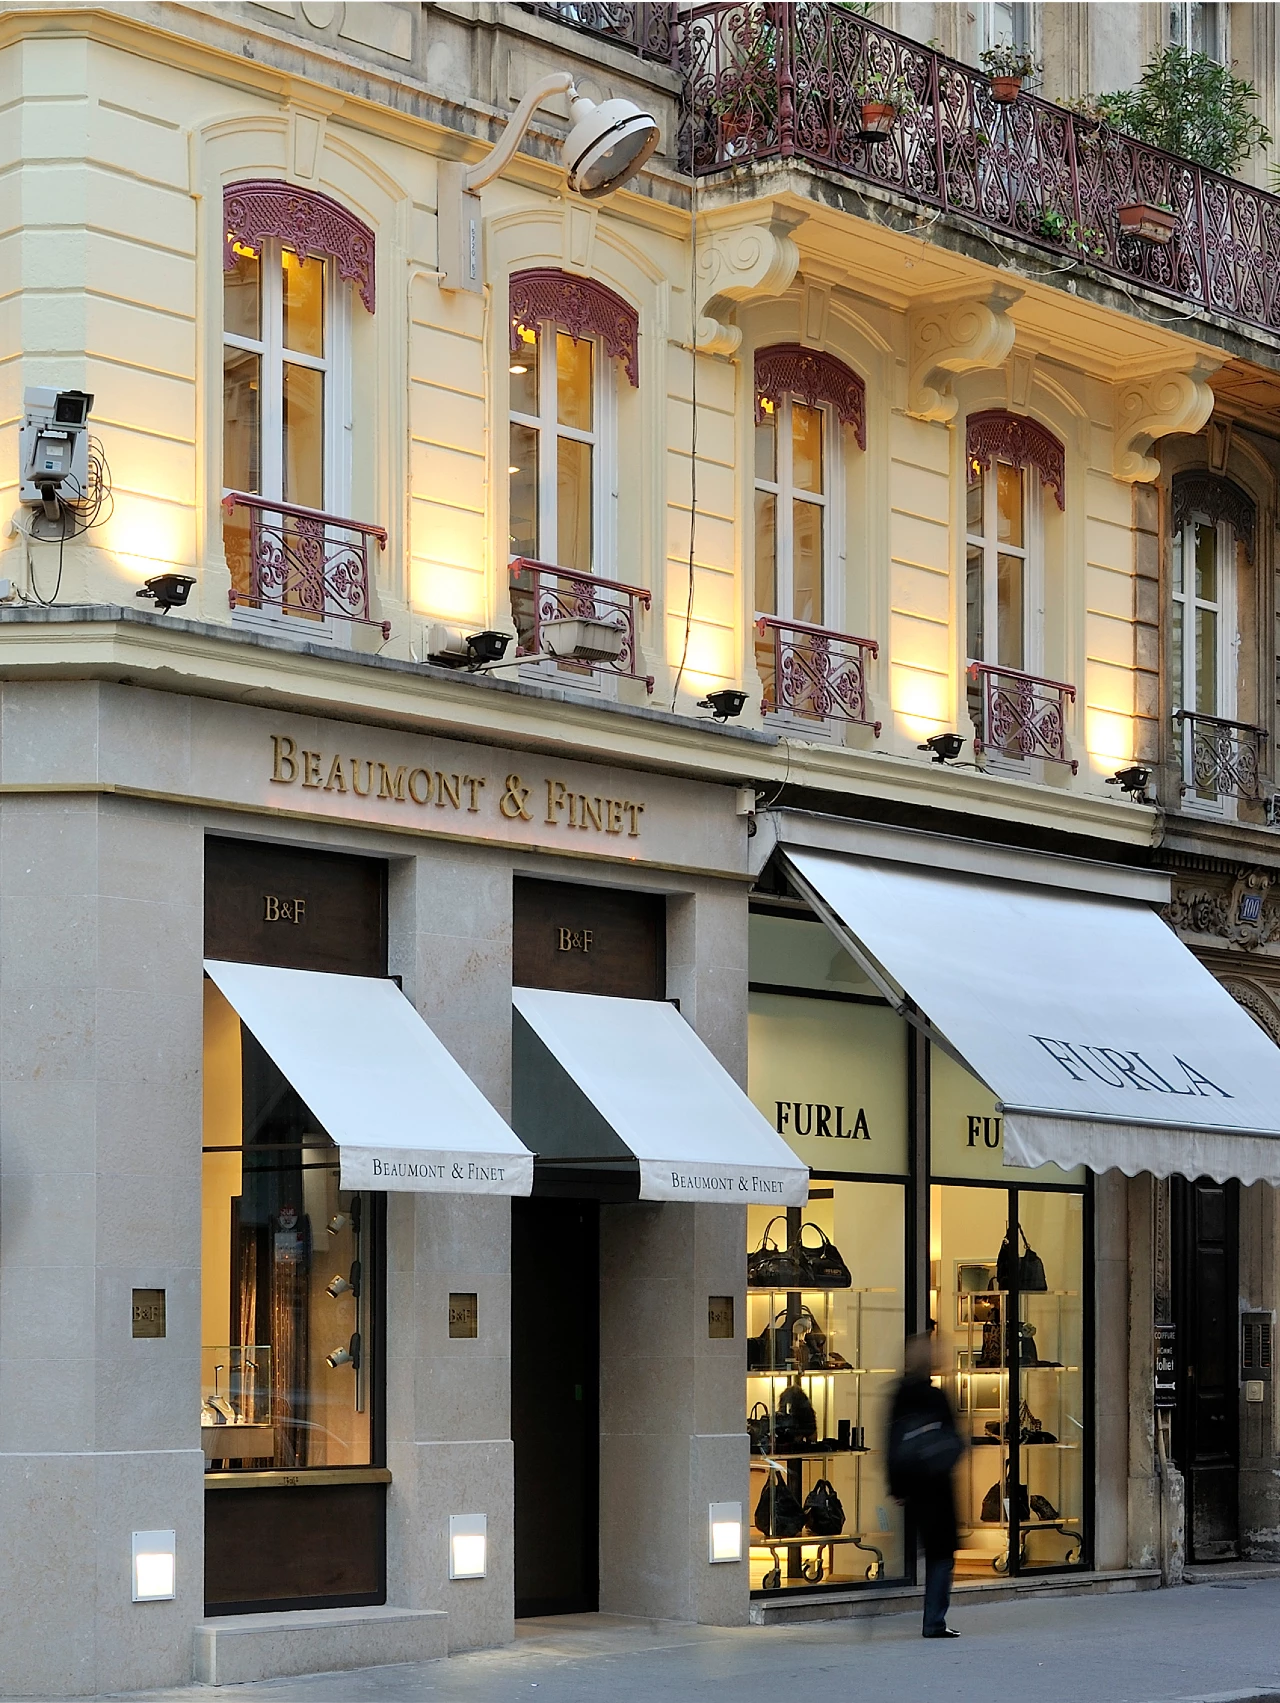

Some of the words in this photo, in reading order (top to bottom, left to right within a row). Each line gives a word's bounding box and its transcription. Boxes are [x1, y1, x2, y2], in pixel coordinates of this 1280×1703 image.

[269, 734, 486, 813] BEAUMONT
[499, 773, 534, 821] &
[544, 778, 645, 837] FINET
[264, 895, 306, 924] B&F
[1243, 898, 1260, 918] 100
[558, 927, 593, 953] B&F
[1028, 1033, 1235, 1099] FURLA
[775, 1101, 872, 1141] FURLA
[966, 1115, 1003, 1149] FU
[372, 1158, 445, 1179] BEAUMONT
[451, 1162, 464, 1180] &
[468, 1162, 505, 1181] FINET
[671, 1171, 734, 1190] BEAUMONT
[738, 1174, 749, 1191] &
[752, 1175, 784, 1193] FINET
